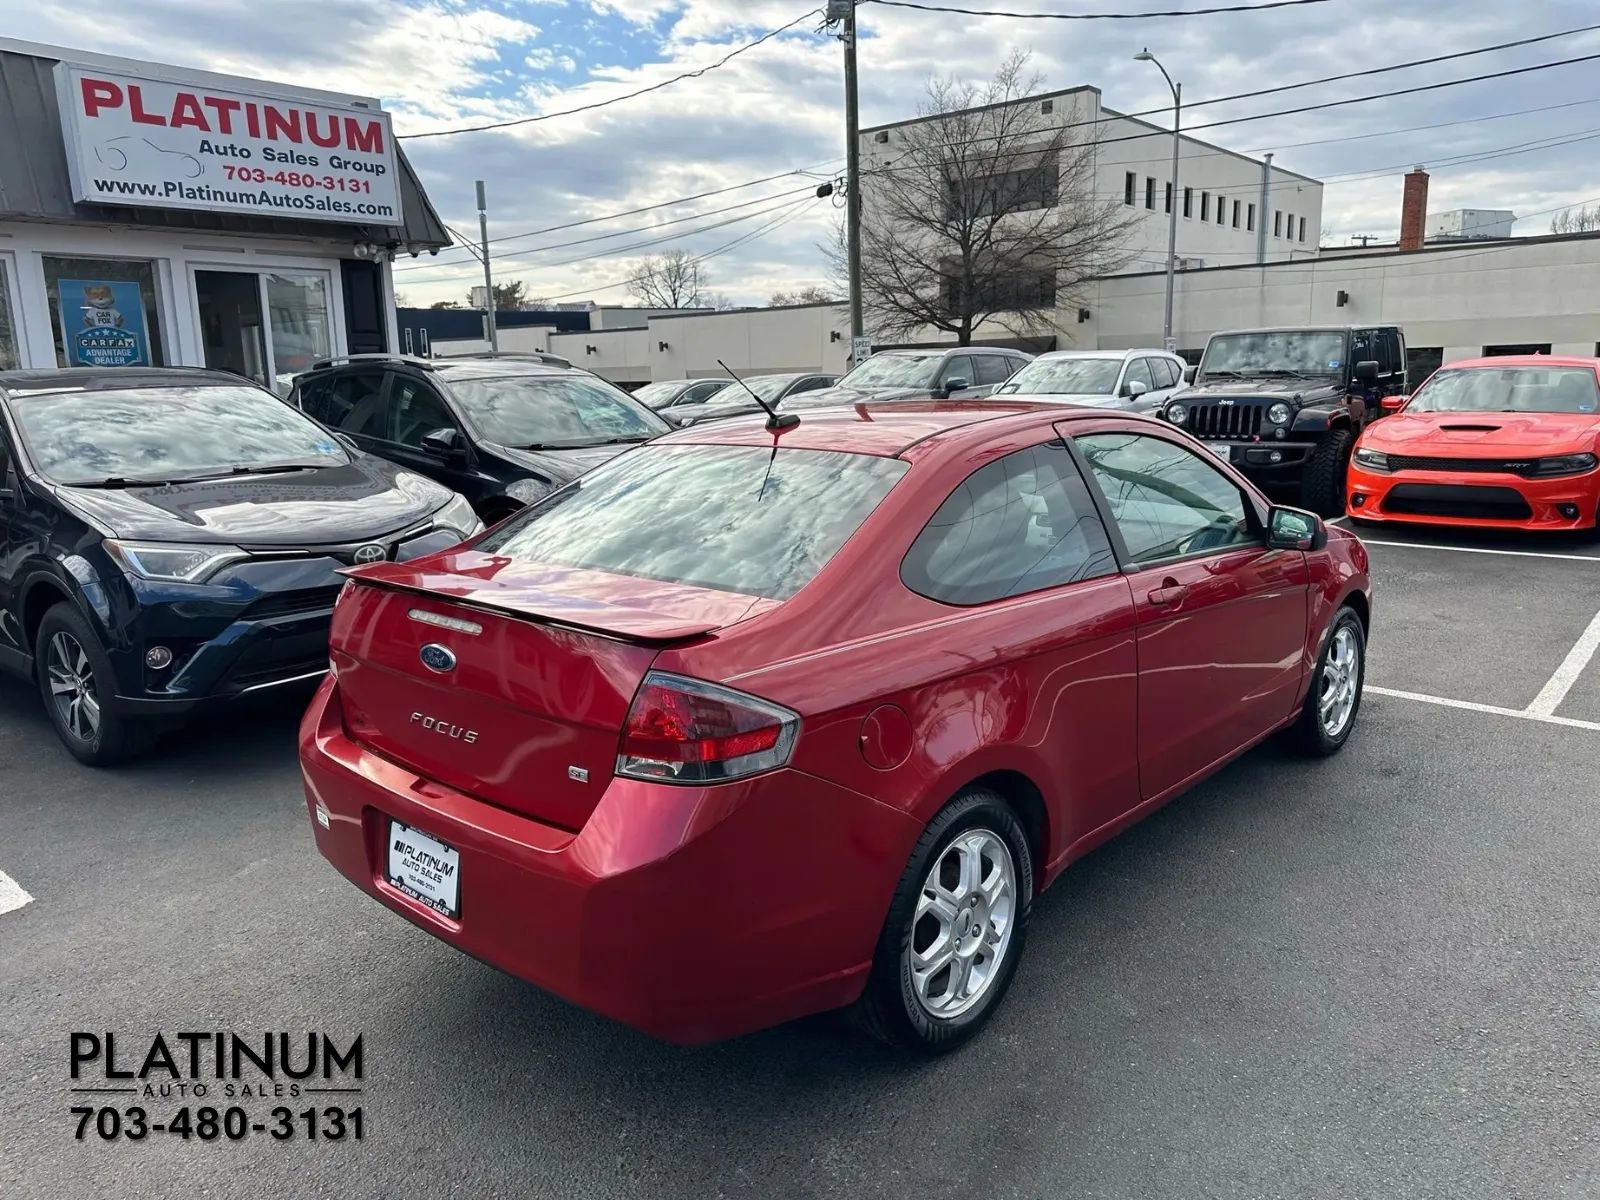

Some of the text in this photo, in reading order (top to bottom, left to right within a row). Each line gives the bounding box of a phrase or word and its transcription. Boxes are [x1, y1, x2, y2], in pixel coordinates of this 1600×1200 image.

[80, 77, 384, 155] PLATINUM
[199, 139, 386, 176] Auto Sales Group
[222, 165, 371, 194] 703-480-3131
[94, 177, 393, 217] www.PlatinumAutoSales.com
[80, 339, 135, 347] CARFAX
[86, 348, 132, 357] ADVANTAGE
[410, 712, 479, 743] FOCUS
[402, 858, 443, 883] AUTO SALES
[404, 844, 454, 878] PLATINUM
[418, 896, 432, 907] AUTO
[433, 902, 450, 916] SALES
